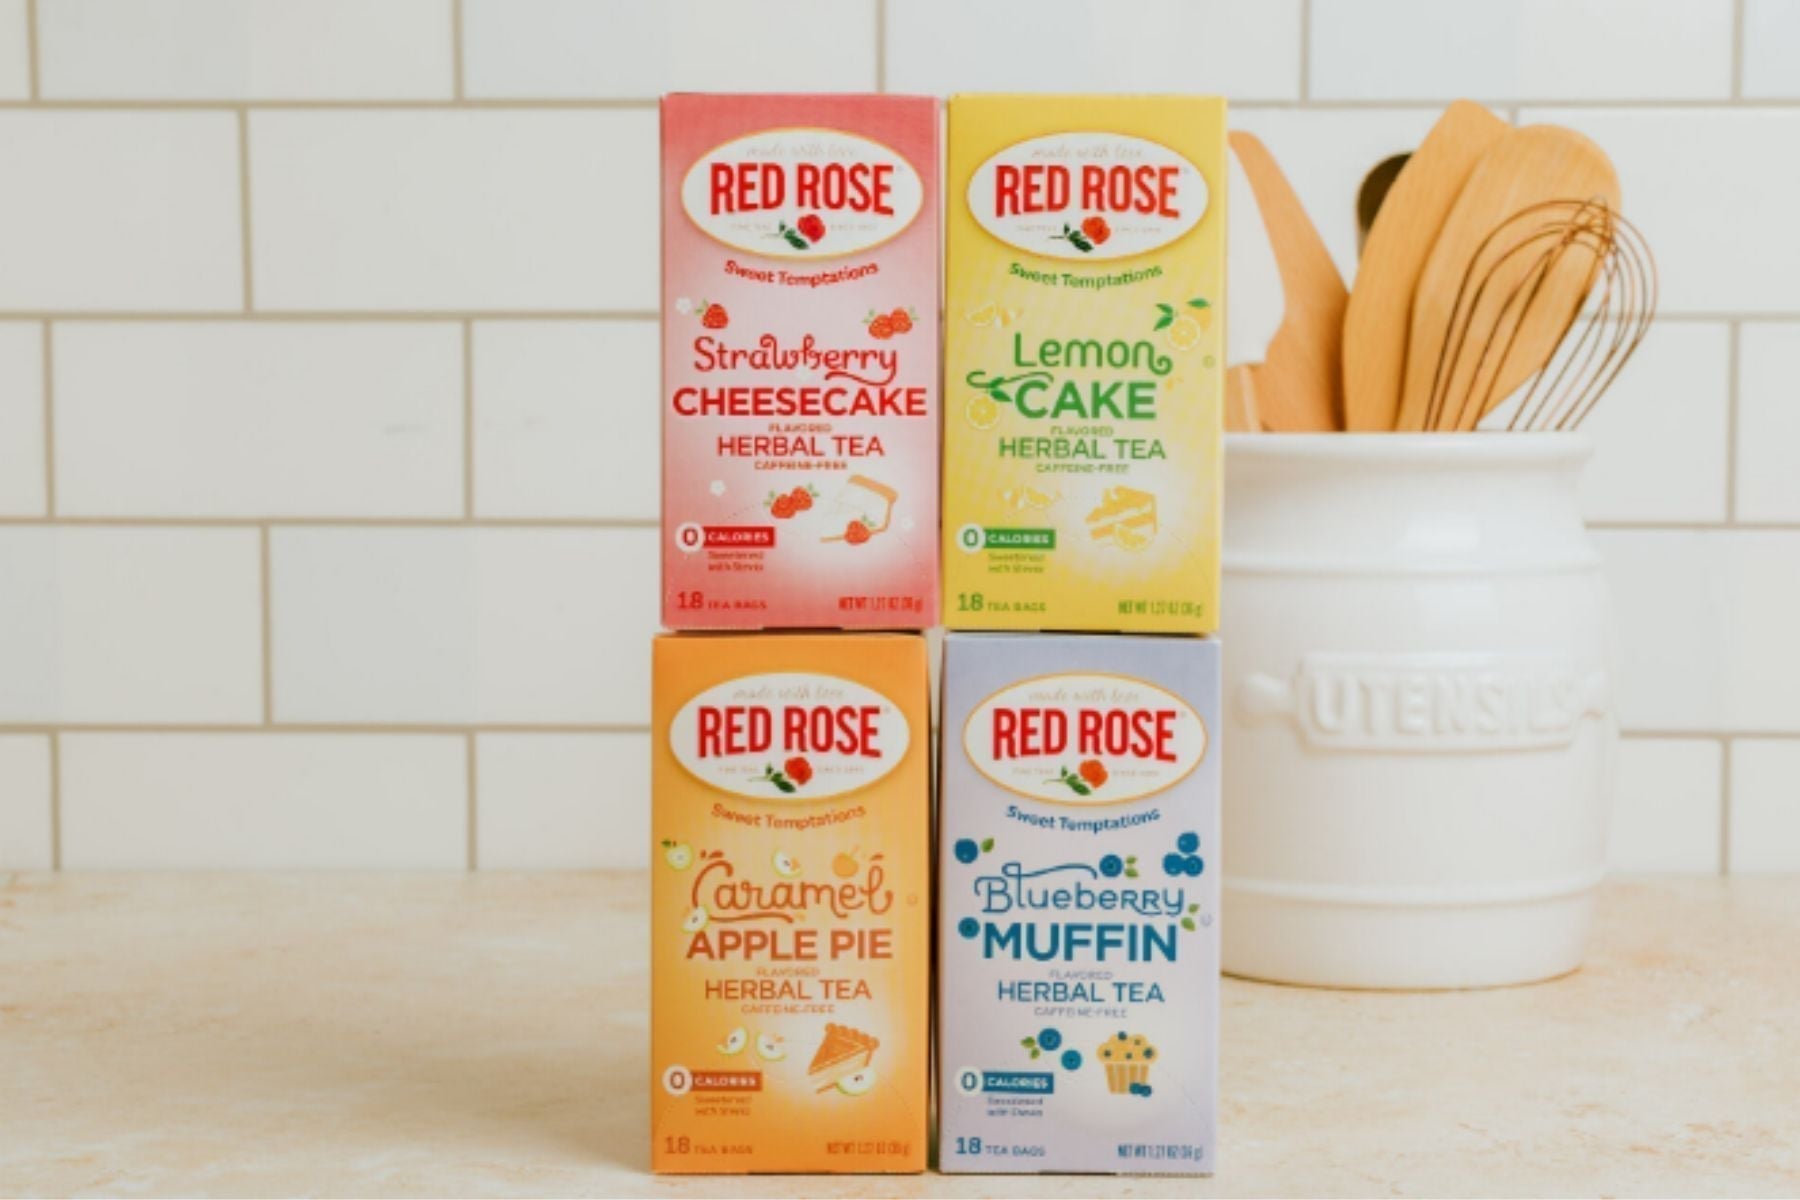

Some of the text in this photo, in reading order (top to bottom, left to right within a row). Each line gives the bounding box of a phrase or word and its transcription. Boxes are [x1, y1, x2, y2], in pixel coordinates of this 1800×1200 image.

[710, 162, 895, 217] RED ROSE
[995, 164, 1180, 219] RED ROSE
[723, 259, 880, 288] Sweet Temptations
[1008, 262, 1163, 290] Sweet Temptations
[693, 333, 898, 387] Strawberry
[1014, 332, 1174, 376] Lemon
[672, 387, 928, 417] CHEESECAKE
[1014, 379, 1158, 420] CAKE
[1050, 425, 1114, 436] FLAVORED
[716, 435, 885, 457] HERBAL TEA
[998, 437, 1167, 459] HERBAL TEA
[1036, 463, 1130, 474] CAFFEINE-FREE
[682, 527, 770, 546] 0 CALORIES
[963, 528, 1050, 547] 0 CALORIES
[677, 591, 704, 610] 18
[957, 592, 984, 612] 18
[987, 602, 1010, 612] TEA
[1306, 672, 1577, 736] UTENSILS
[697, 705, 882, 759] RED ROSE
[993, 708, 1177, 763] RED ROSE
[710, 803, 867, 832] Sweet Temptations
[1006, 804, 1161, 834] Sweet Temptations
[691, 860, 895, 924] Caramel
[973, 861, 1185, 917] Blueberry
[685, 929, 894, 961] APPLE PIE
[982, 921, 1178, 962] MUFFIN
[1049, 969, 1113, 981] FLAVORED
[704, 979, 873, 1001] HERBAL TEA
[997, 980, 1165, 1002] HERBAL TEA
[669, 1071, 757, 1090] 0 CALORIES
[961, 1072, 1050, 1091] 0 CALORIES
[664, 1136, 691, 1155] 18
[955, 1137, 982, 1155] 18
[985, 1145, 1008, 1155] TEA
